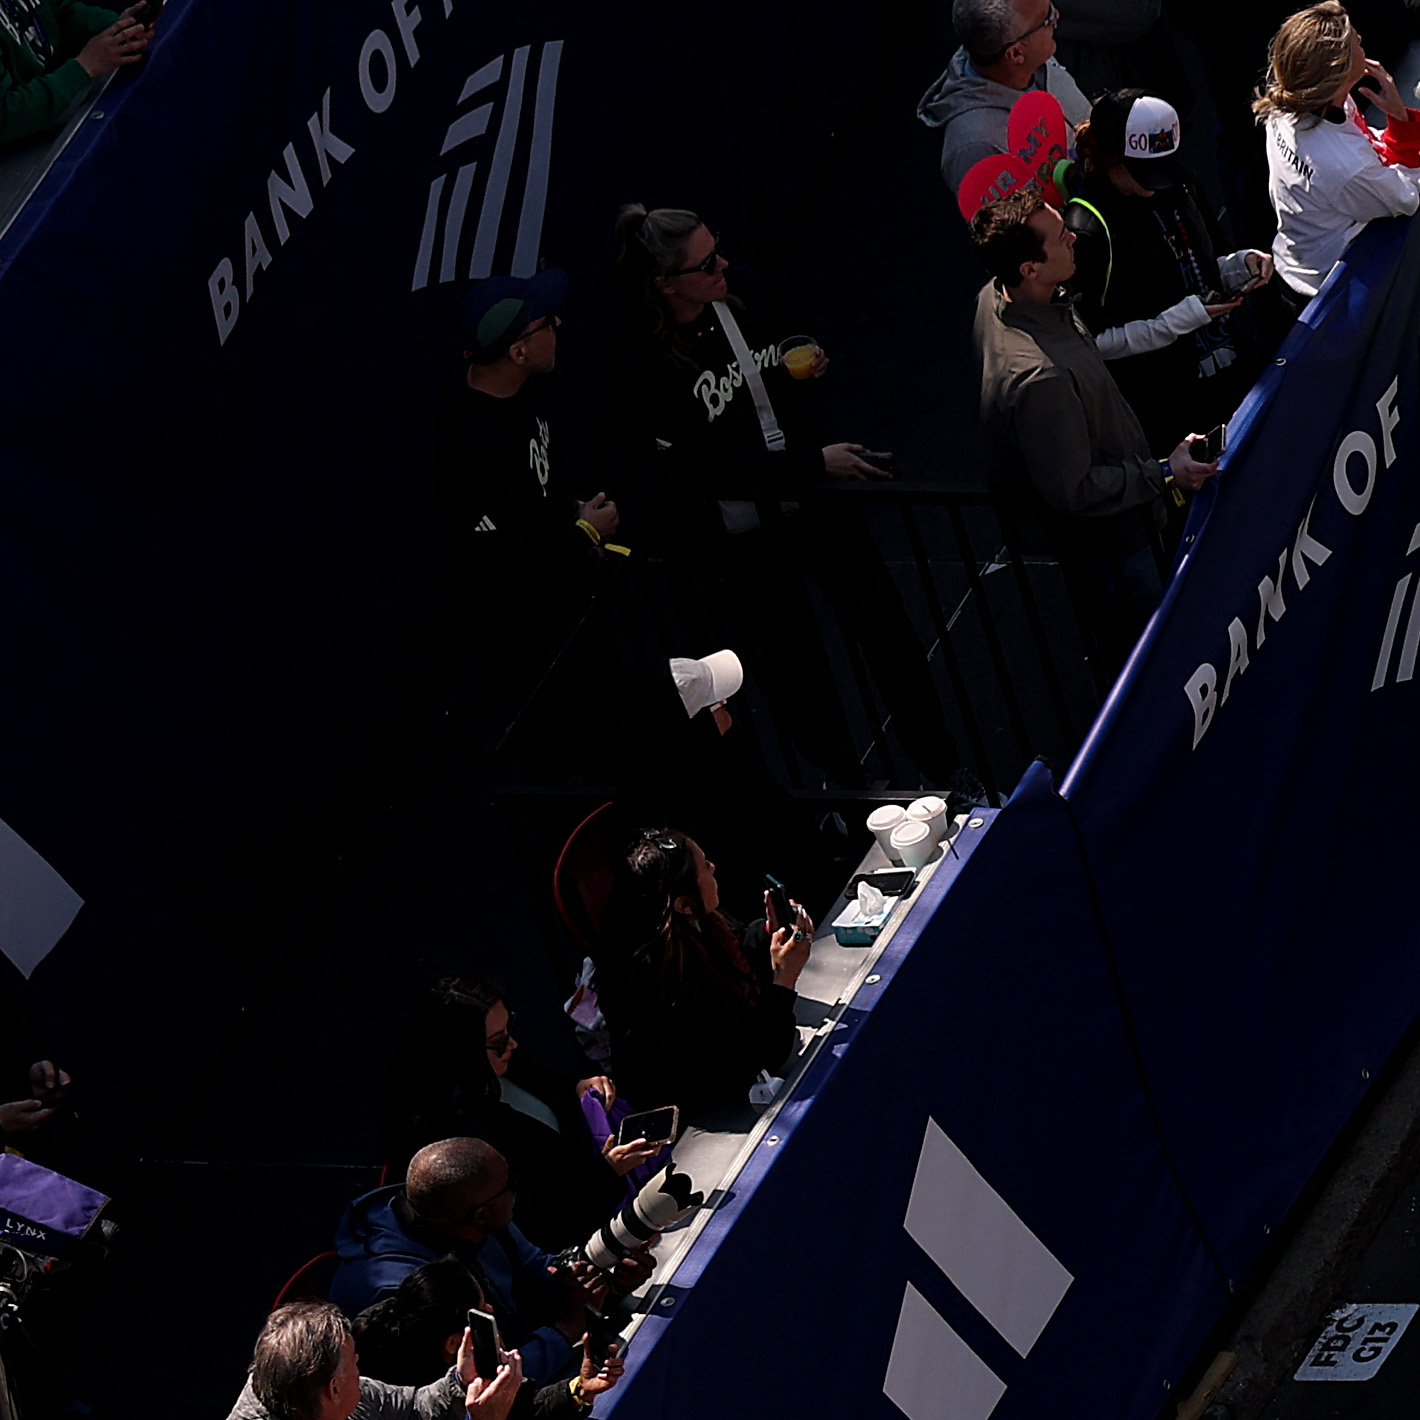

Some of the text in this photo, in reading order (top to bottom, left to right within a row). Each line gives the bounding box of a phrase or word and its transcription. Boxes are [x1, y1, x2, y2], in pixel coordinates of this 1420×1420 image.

[1017, 116, 1048, 164] MY
[1129, 133, 1148, 151] GO
[1276, 134, 1314, 181] BRITAIN
[208, 0, 423, 347] BANK OF
[693, 343, 780, 424] Boson
[1184, 494, 1333, 751] BANK
[1333, 376, 1400, 515] OF
[5, 1217, 47, 1241] LYNX
[1352, 1320, 1398, 1364] G13
